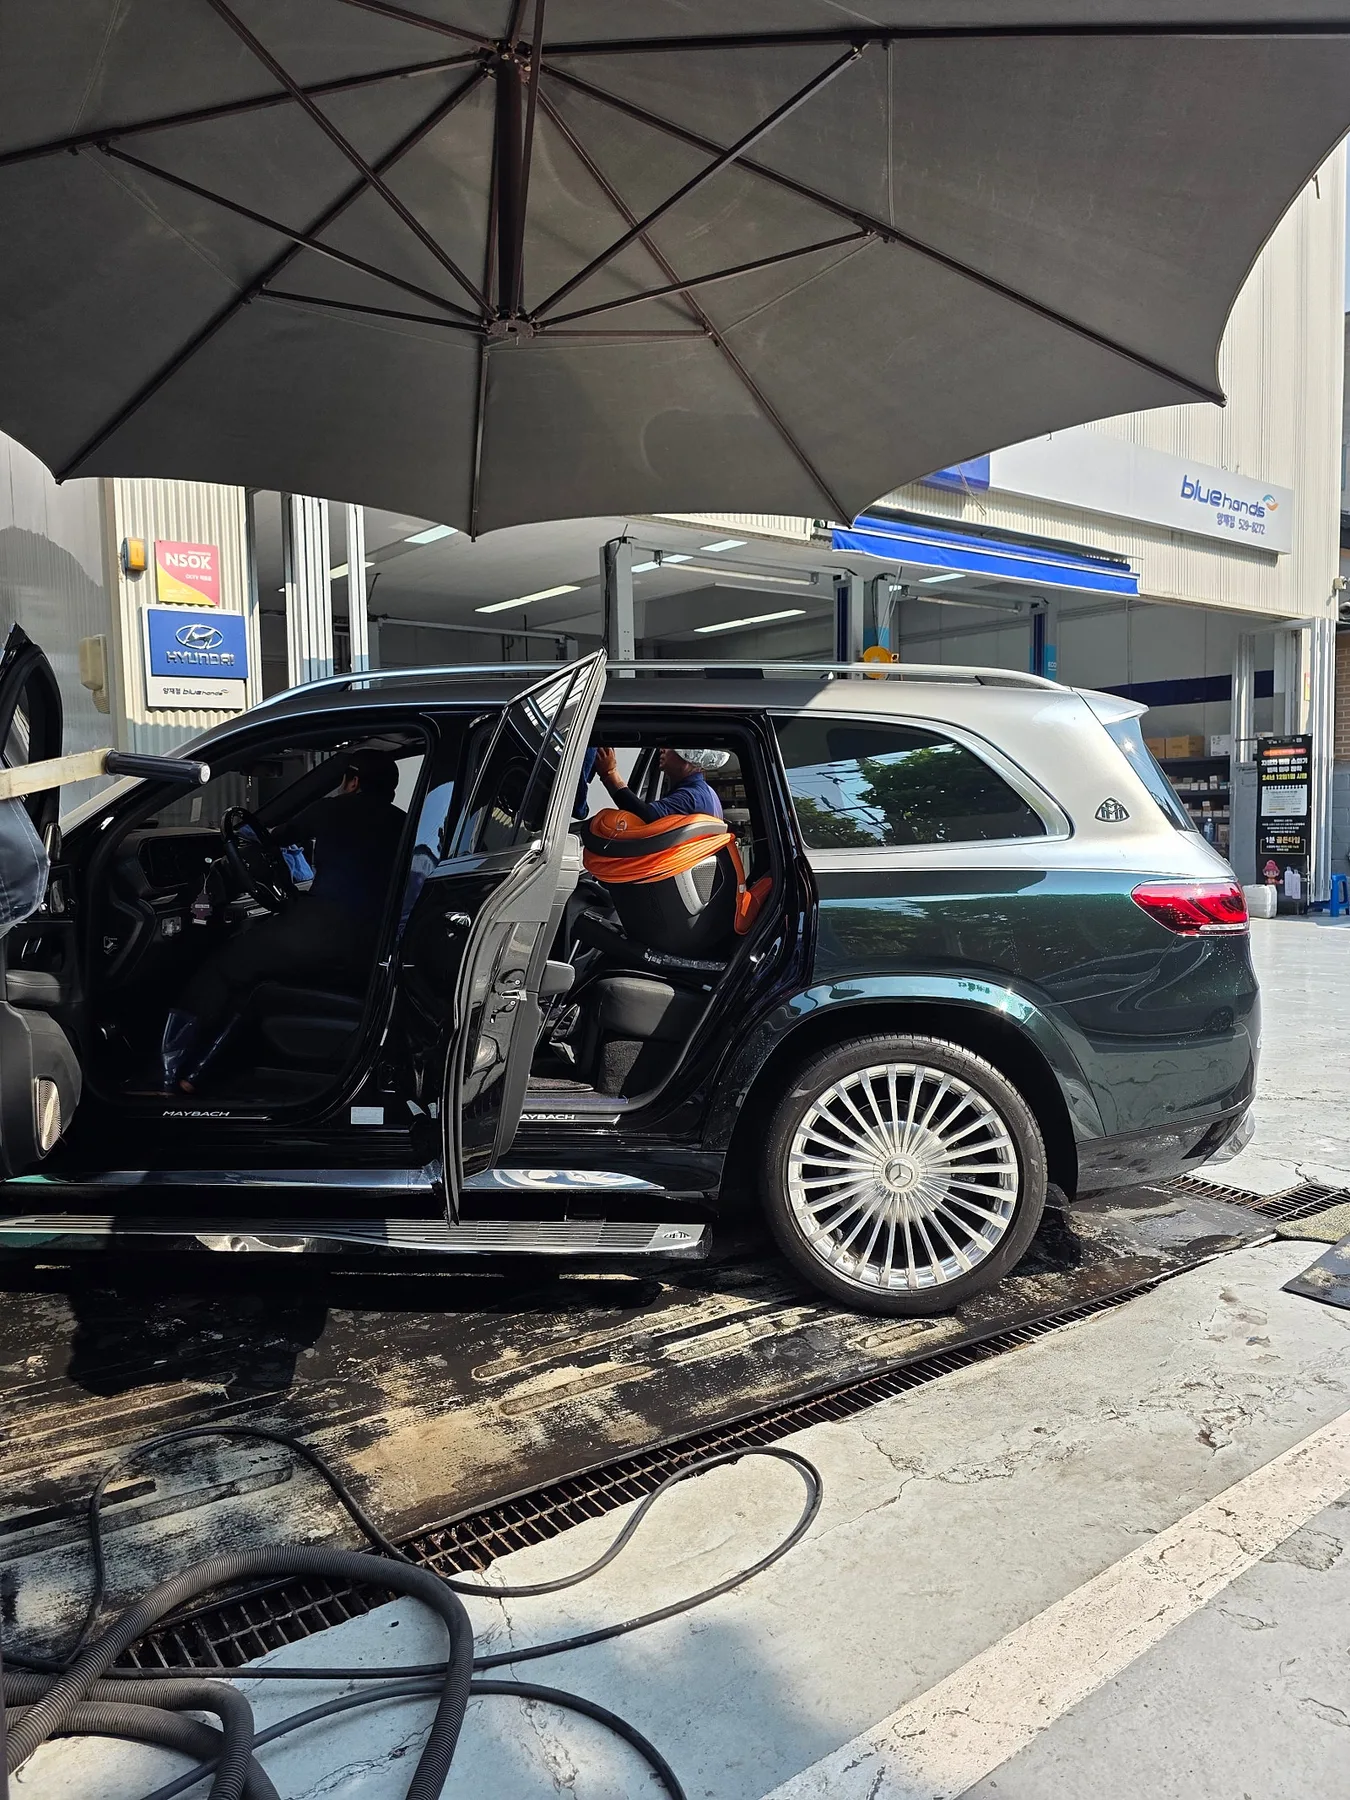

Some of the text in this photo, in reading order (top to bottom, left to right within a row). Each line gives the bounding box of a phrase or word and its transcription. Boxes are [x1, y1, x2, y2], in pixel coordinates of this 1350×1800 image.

[165, 552, 212, 570] NSOK
[166, 650, 235, 666] HYUNDAI
[162, 687, 181, 695] 양재점
